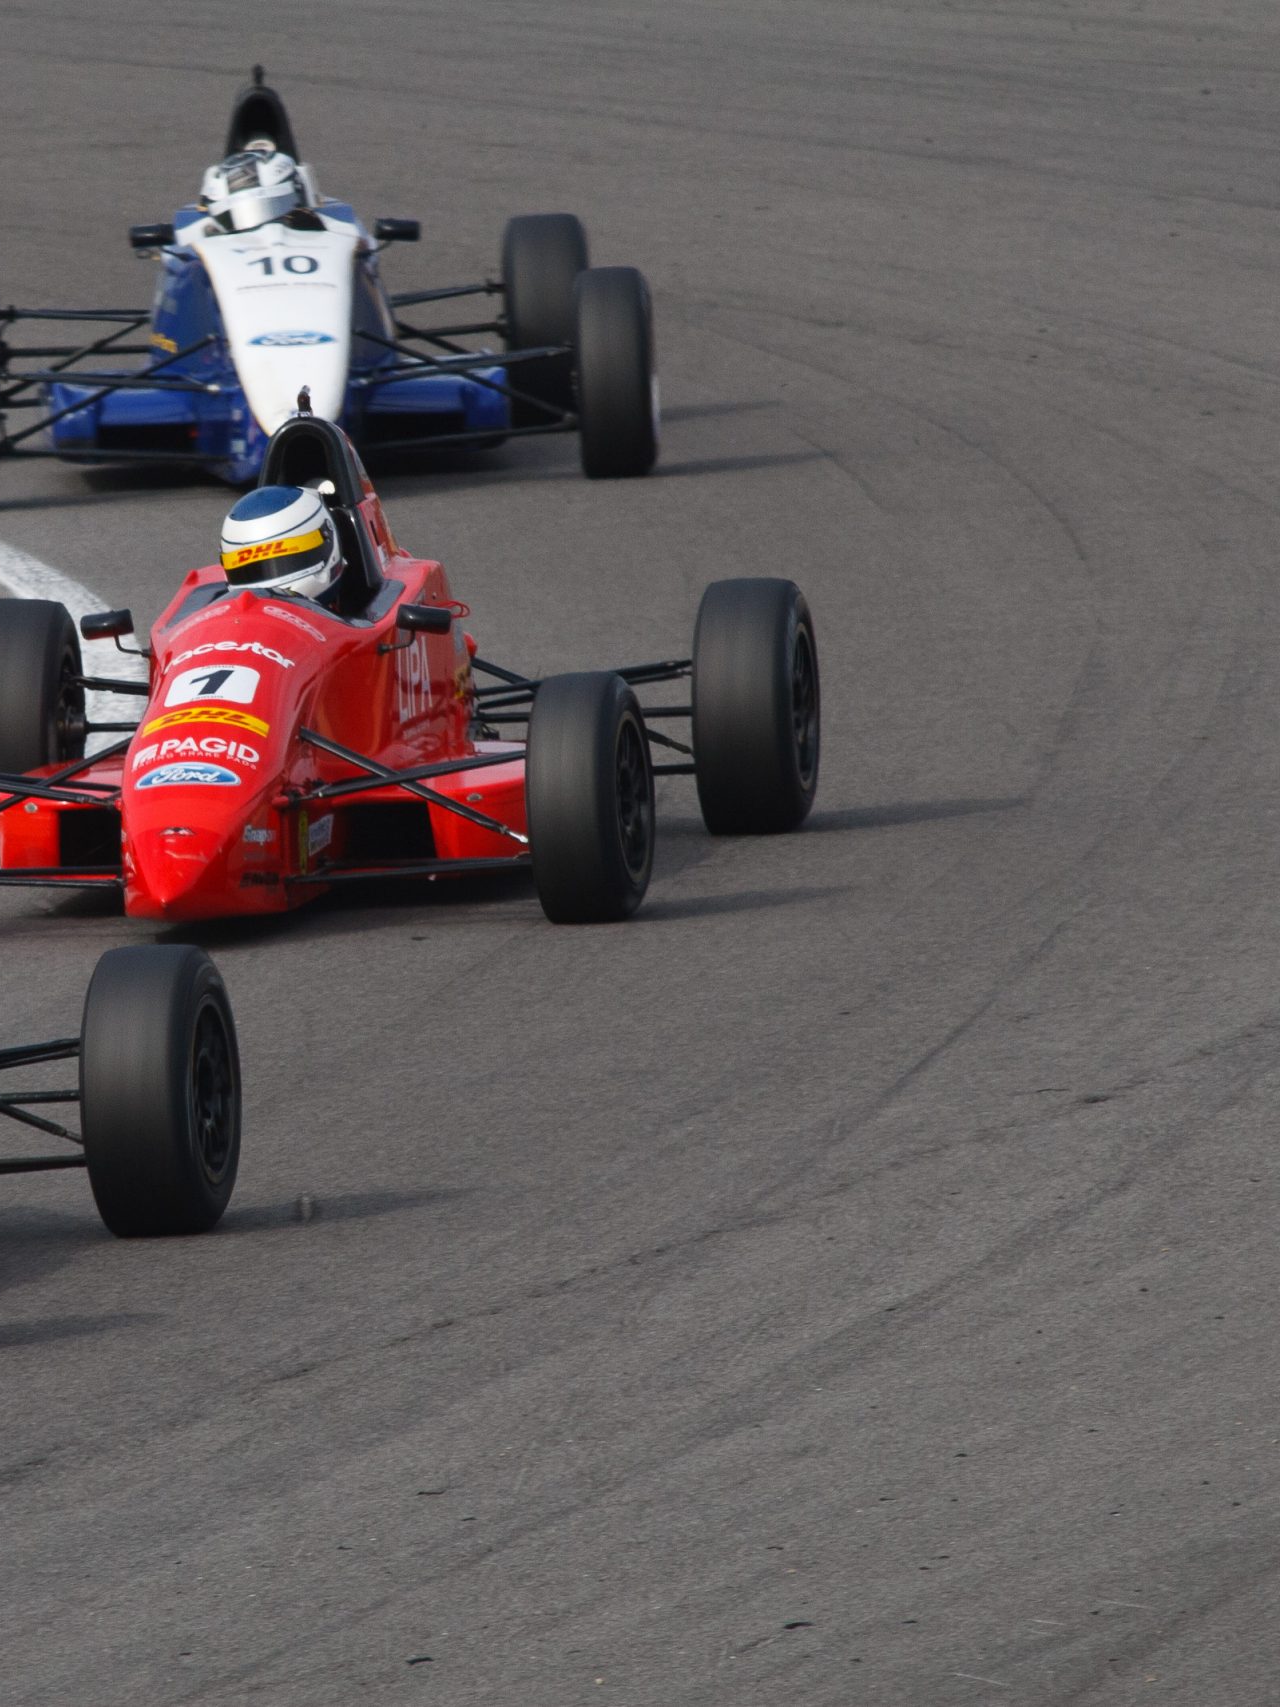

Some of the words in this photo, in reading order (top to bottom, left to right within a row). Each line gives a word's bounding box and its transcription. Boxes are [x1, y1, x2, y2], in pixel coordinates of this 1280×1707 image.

[247, 255, 319, 275] 10
[237, 541, 288, 563] DHL
[190, 669, 235, 695] 1
[160, 710, 251, 727] DHL
[160, 737, 260, 763] PAGID
[151, 766, 219, 784] Ford
